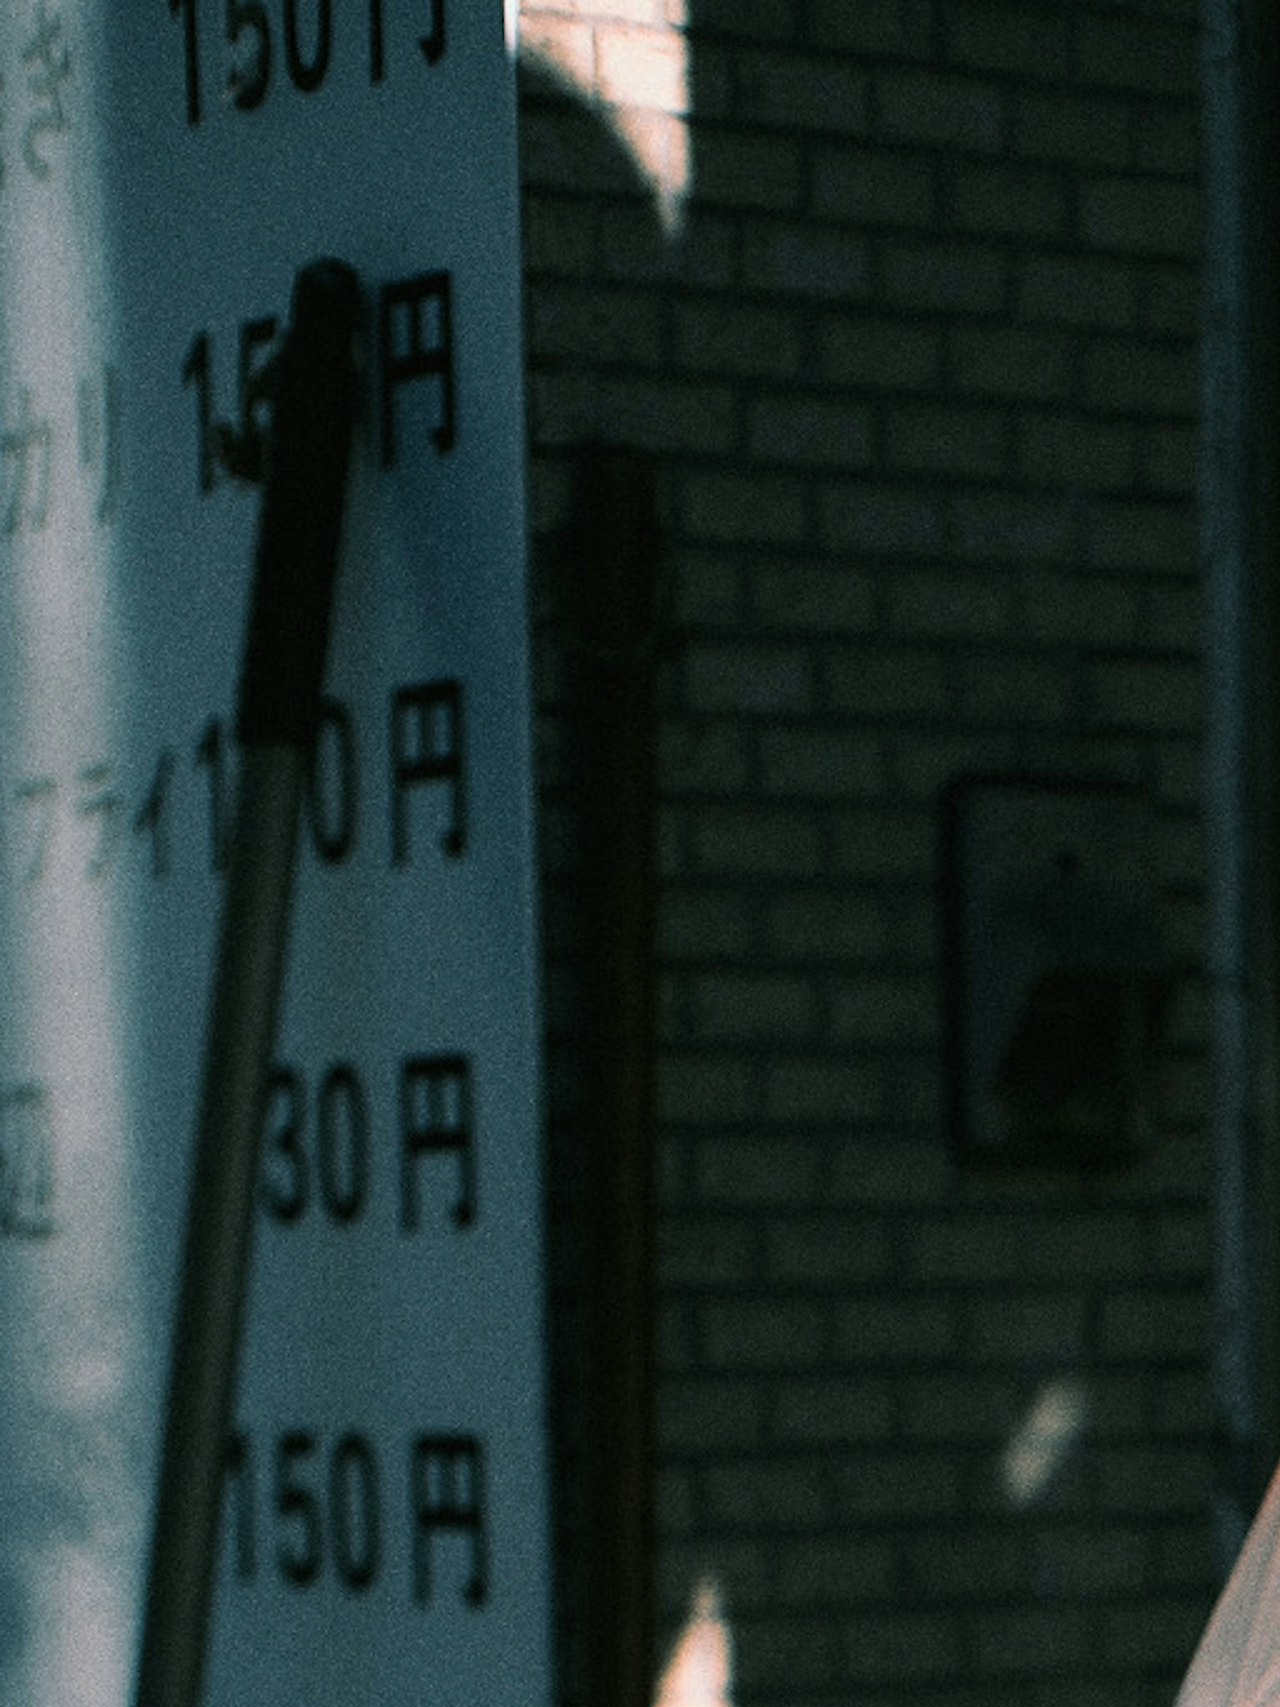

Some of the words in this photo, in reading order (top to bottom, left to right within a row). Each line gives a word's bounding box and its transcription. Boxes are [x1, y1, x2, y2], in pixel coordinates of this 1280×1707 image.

[183, 270, 456, 497] 15円
[190, 681, 467, 874] 10円
[225, 1432, 489, 1609] 150円
